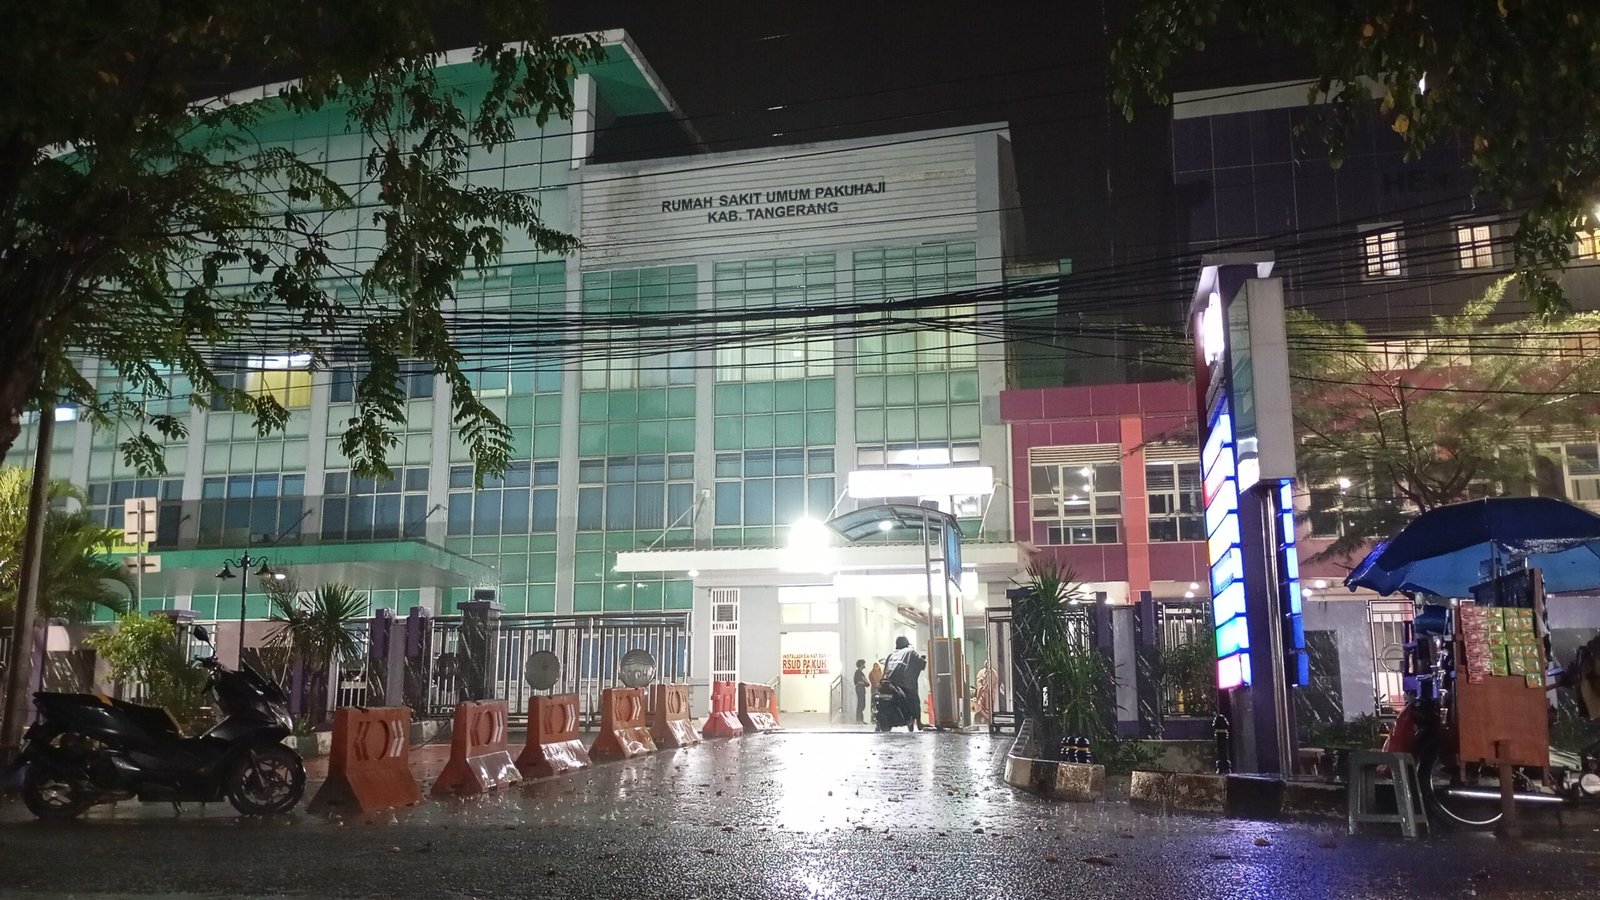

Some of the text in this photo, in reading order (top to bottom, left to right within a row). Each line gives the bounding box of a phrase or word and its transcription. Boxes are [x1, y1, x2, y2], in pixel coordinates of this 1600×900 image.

[661, 181, 886, 213] RUMAH SAKIT UMUM PAKUHAJI
[707, 202, 839, 223] KAB. TANGERANG
[783, 659, 829, 669] RSUD PAKUH
